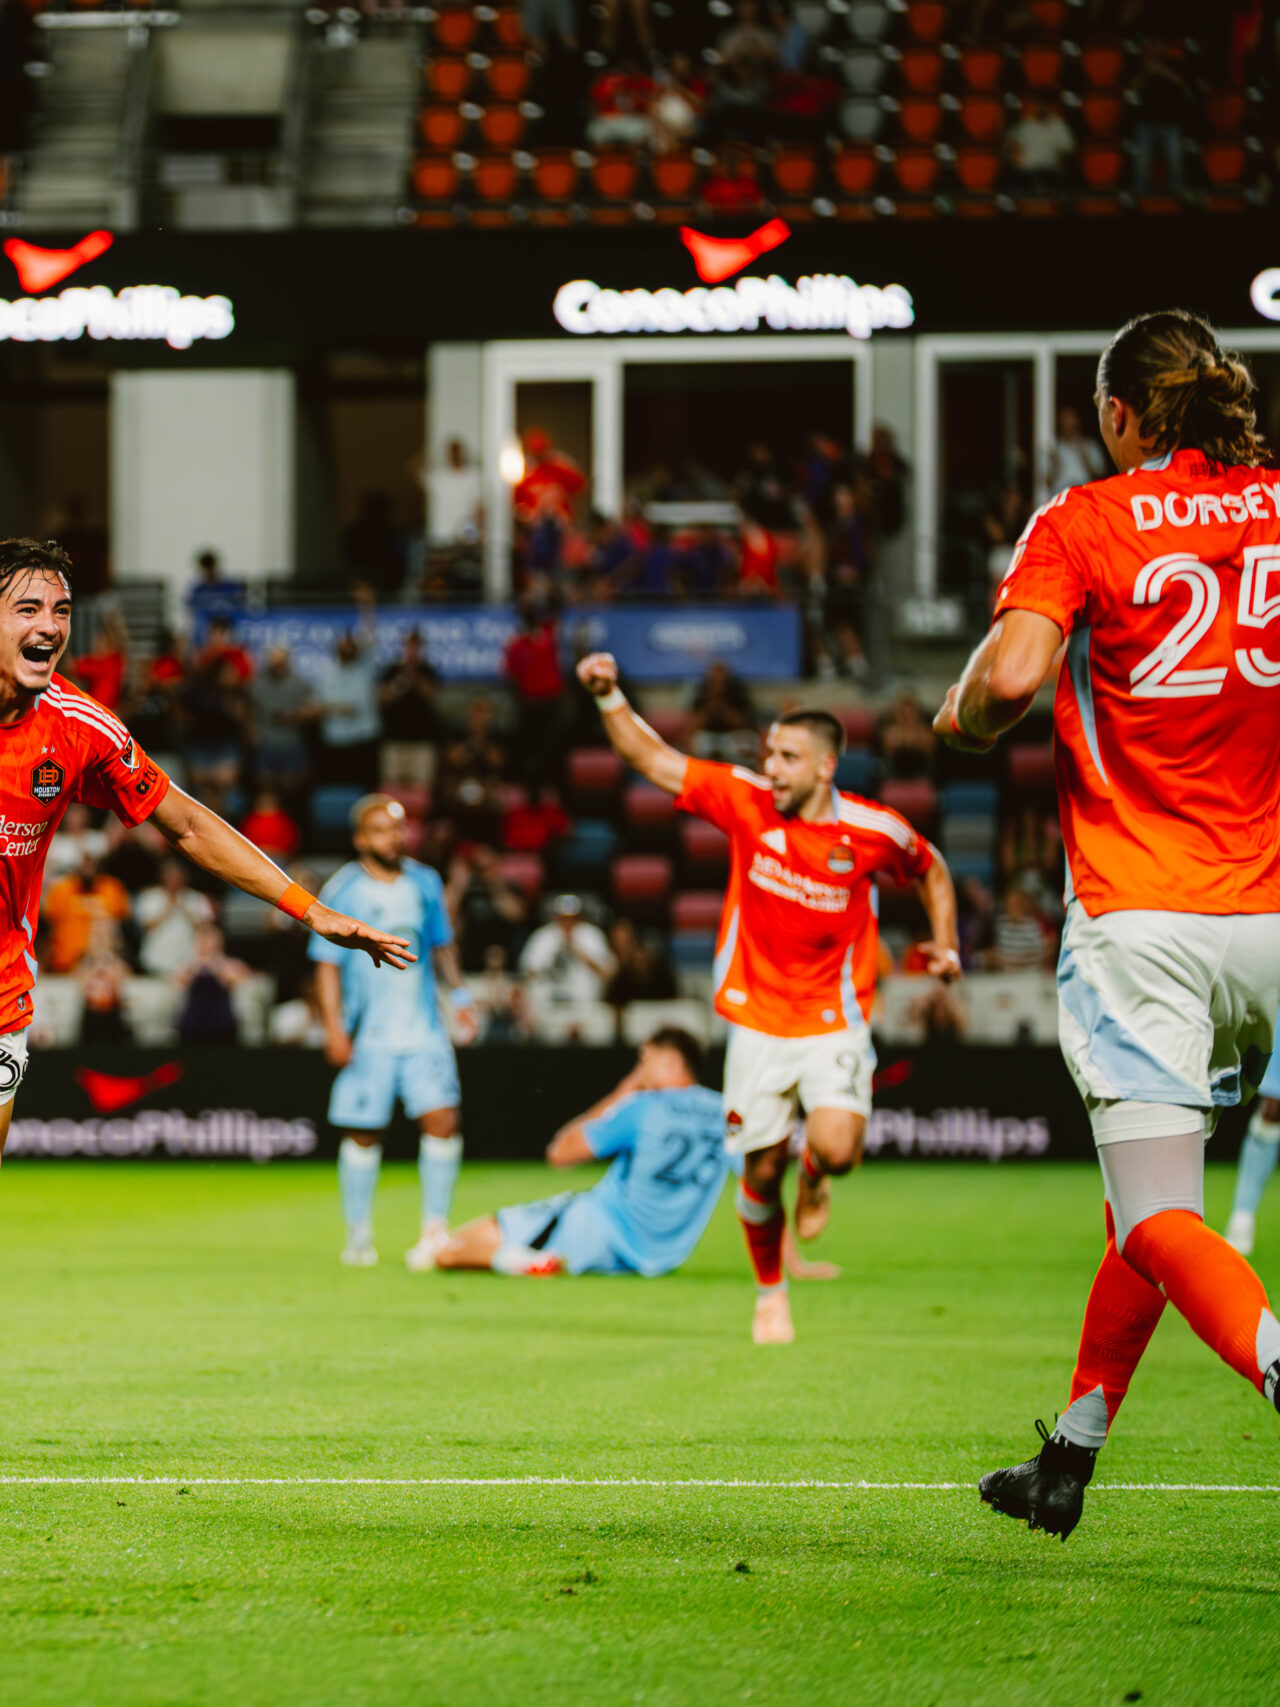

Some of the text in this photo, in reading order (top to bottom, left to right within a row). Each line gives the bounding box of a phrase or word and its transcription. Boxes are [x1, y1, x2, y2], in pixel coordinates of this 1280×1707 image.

[553, 274, 915, 339] ConocoPhillips
[1129, 544, 1280, 698] 25
[33, 785, 61, 795] HOUSTON
[3, 1108, 318, 1164] nocoPhillips
[867, 1107, 1050, 1164] Phillips
